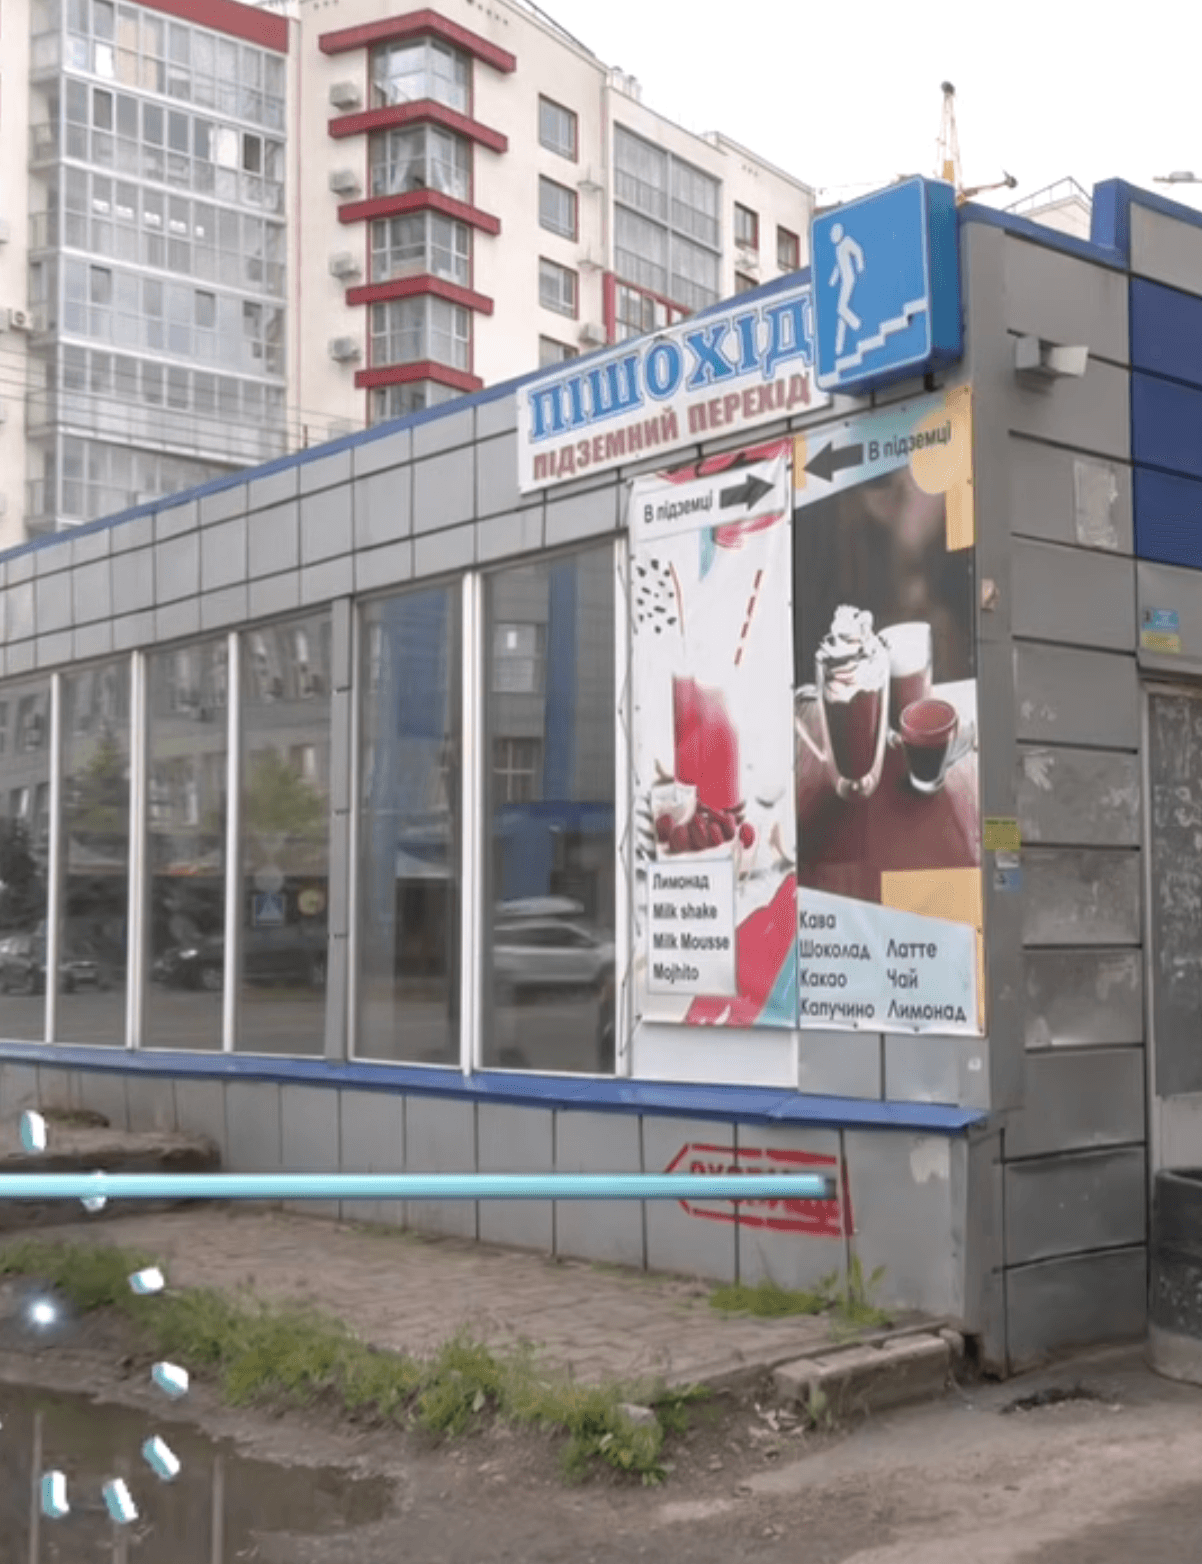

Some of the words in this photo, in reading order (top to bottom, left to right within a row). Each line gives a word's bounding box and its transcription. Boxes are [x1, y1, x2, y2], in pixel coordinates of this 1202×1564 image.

[529, 291, 817, 443] ПІШОХІД
[533, 405, 679, 480] ПІДЗЕМНИЙ
[687, 371, 811, 434] ПЕРЕХІД
[869, 441, 880, 461] В
[883, 420, 952, 458] підземці
[644, 503, 655, 523] В
[656, 489, 713, 520] підземці
[653, 872, 710, 891] Лимонад
[653, 902, 677, 920] Milk
[680, 902, 718, 920] shake
[800, 910, 837, 929] Кава
[653, 932, 678, 950] Milk
[680, 932, 730, 951] Mousse
[799, 938, 872, 960] Шоколад
[886, 938, 938, 959] Латте
[800, 967, 848, 989] Какао
[886, 967, 919, 989] Чай
[799, 997, 876, 1021] Капучино
[886, 998, 967, 1023] Лимонад
